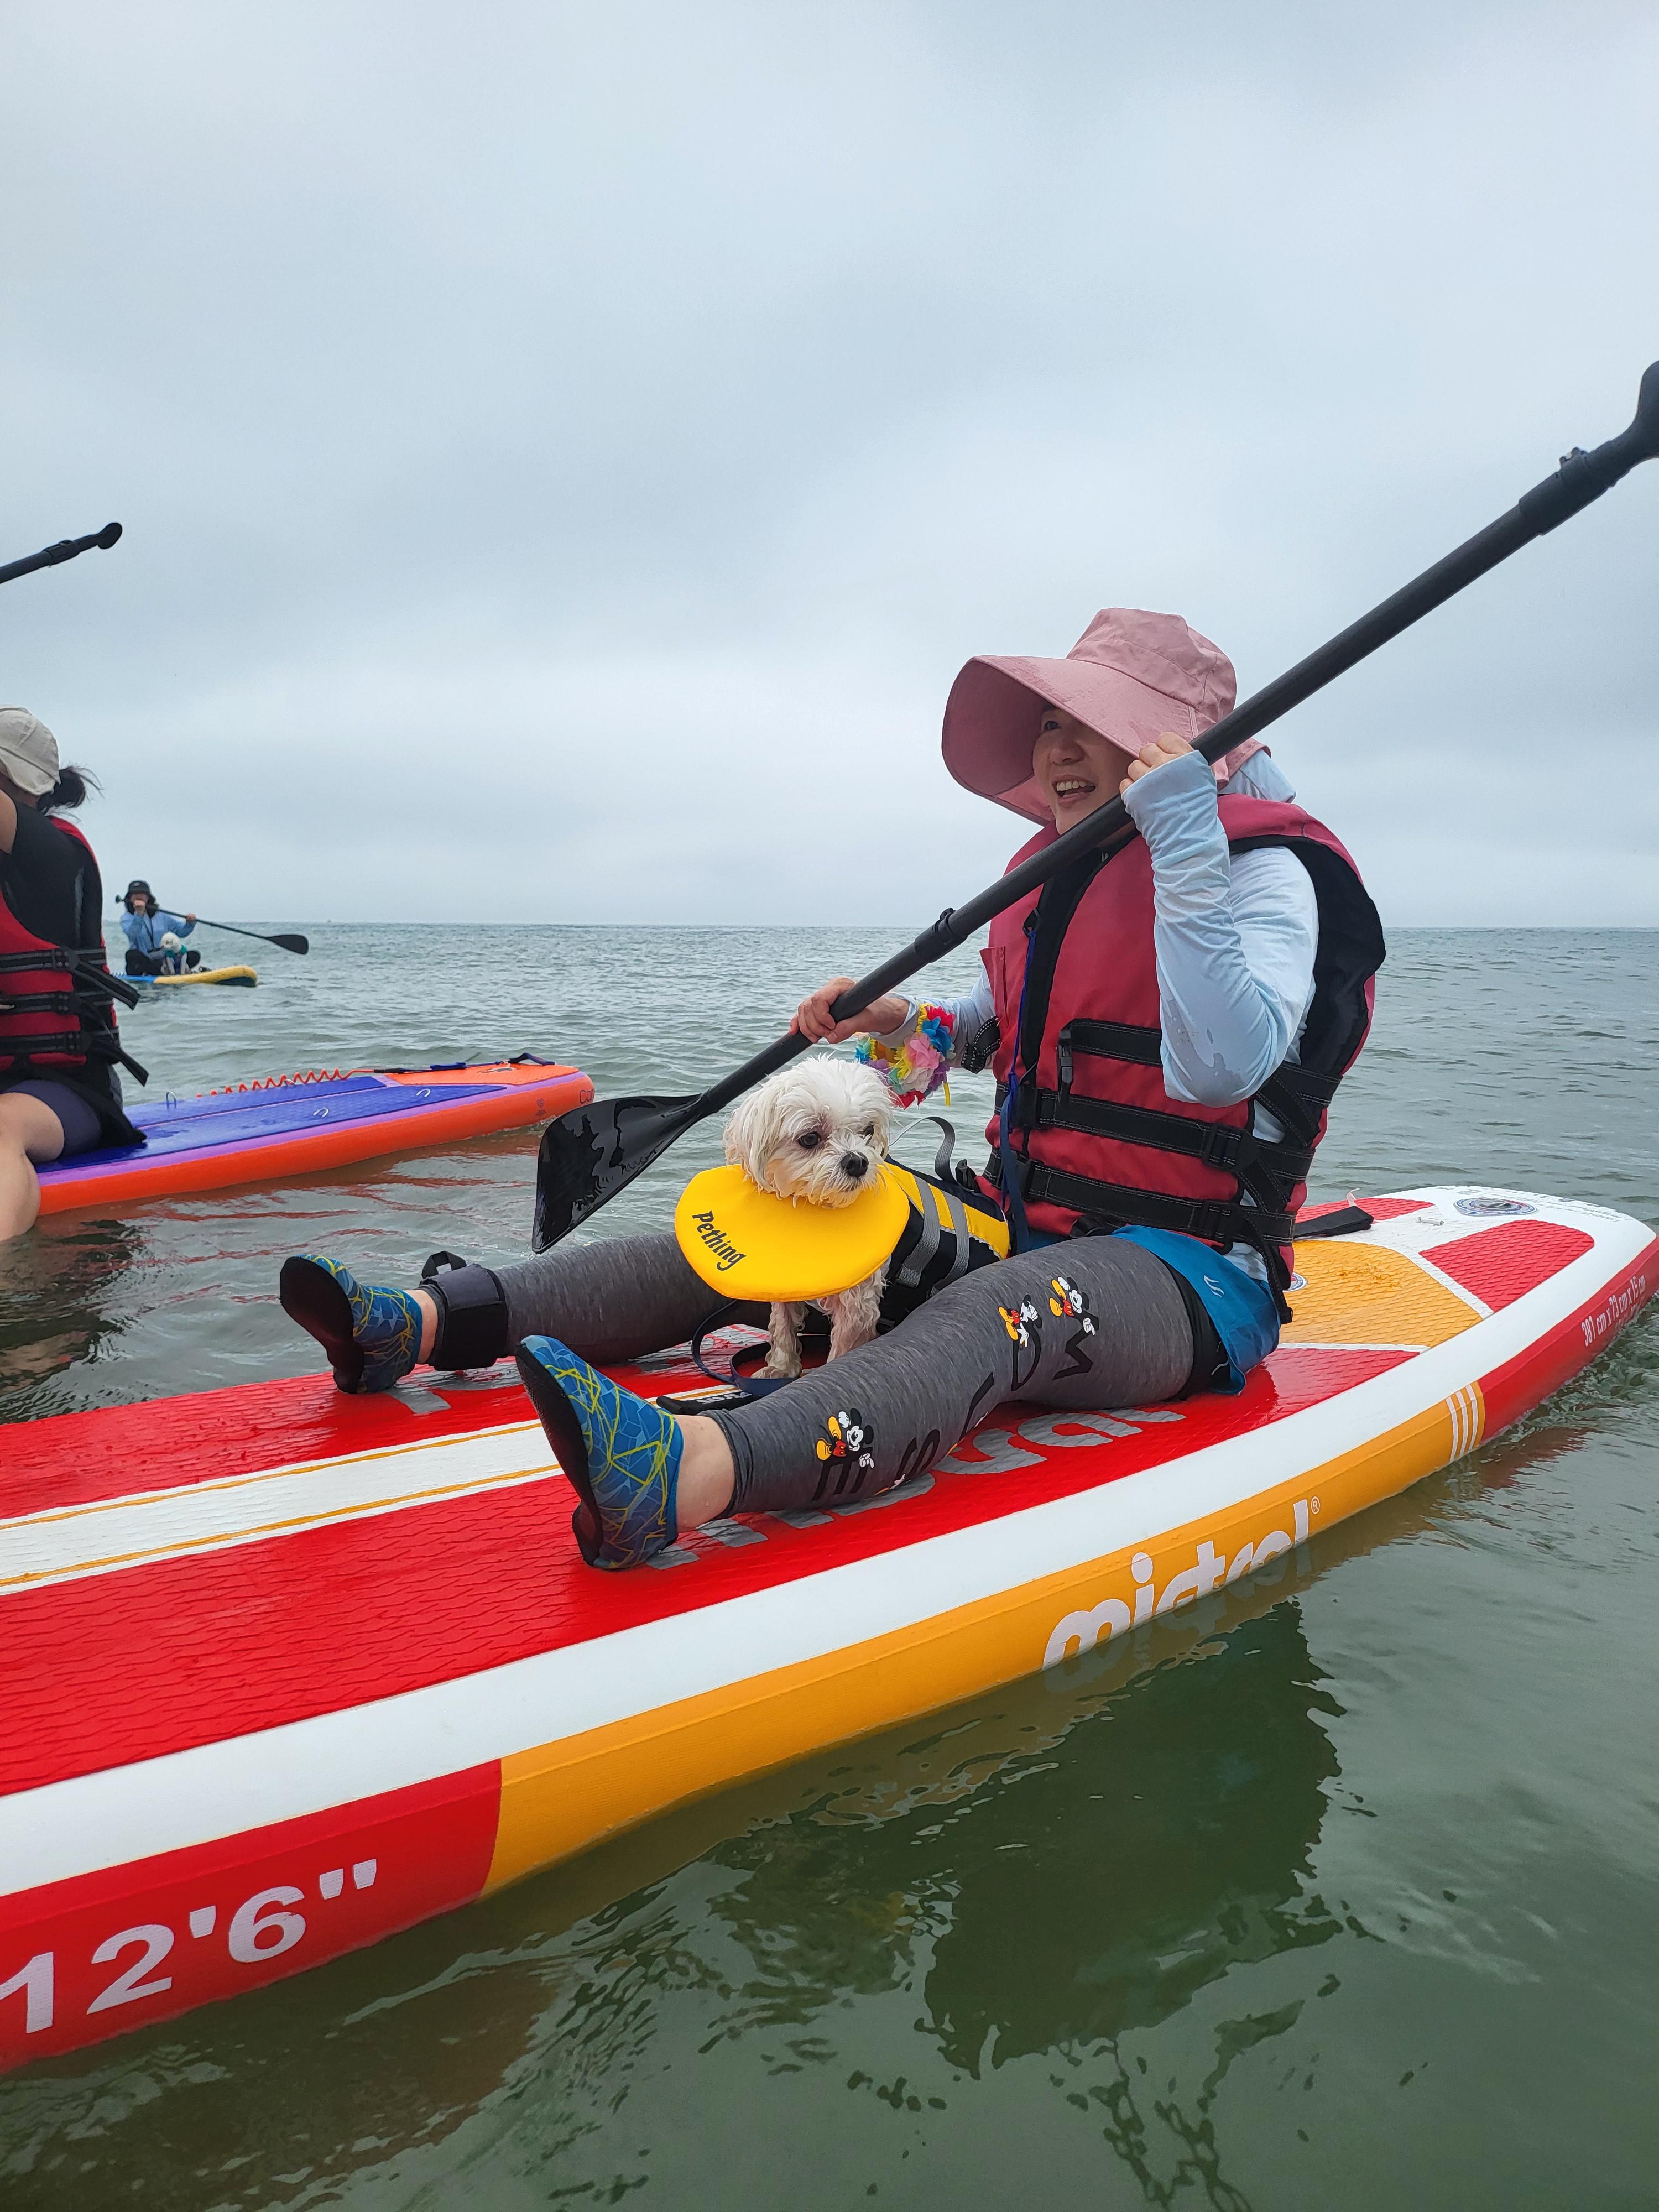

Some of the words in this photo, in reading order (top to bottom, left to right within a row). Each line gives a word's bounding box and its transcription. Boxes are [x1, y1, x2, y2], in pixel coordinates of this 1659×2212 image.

[692, 1209, 748, 1271] Pething
[1581, 1315, 1596, 1347] 381
[1596, 1312, 1607, 1335] cm
[1605, 1308, 1612, 1327] x
[1609, 1295, 1619, 1321] 73
[1619, 1292, 1628, 1313] cm
[1630, 1275, 1639, 1301] 15
